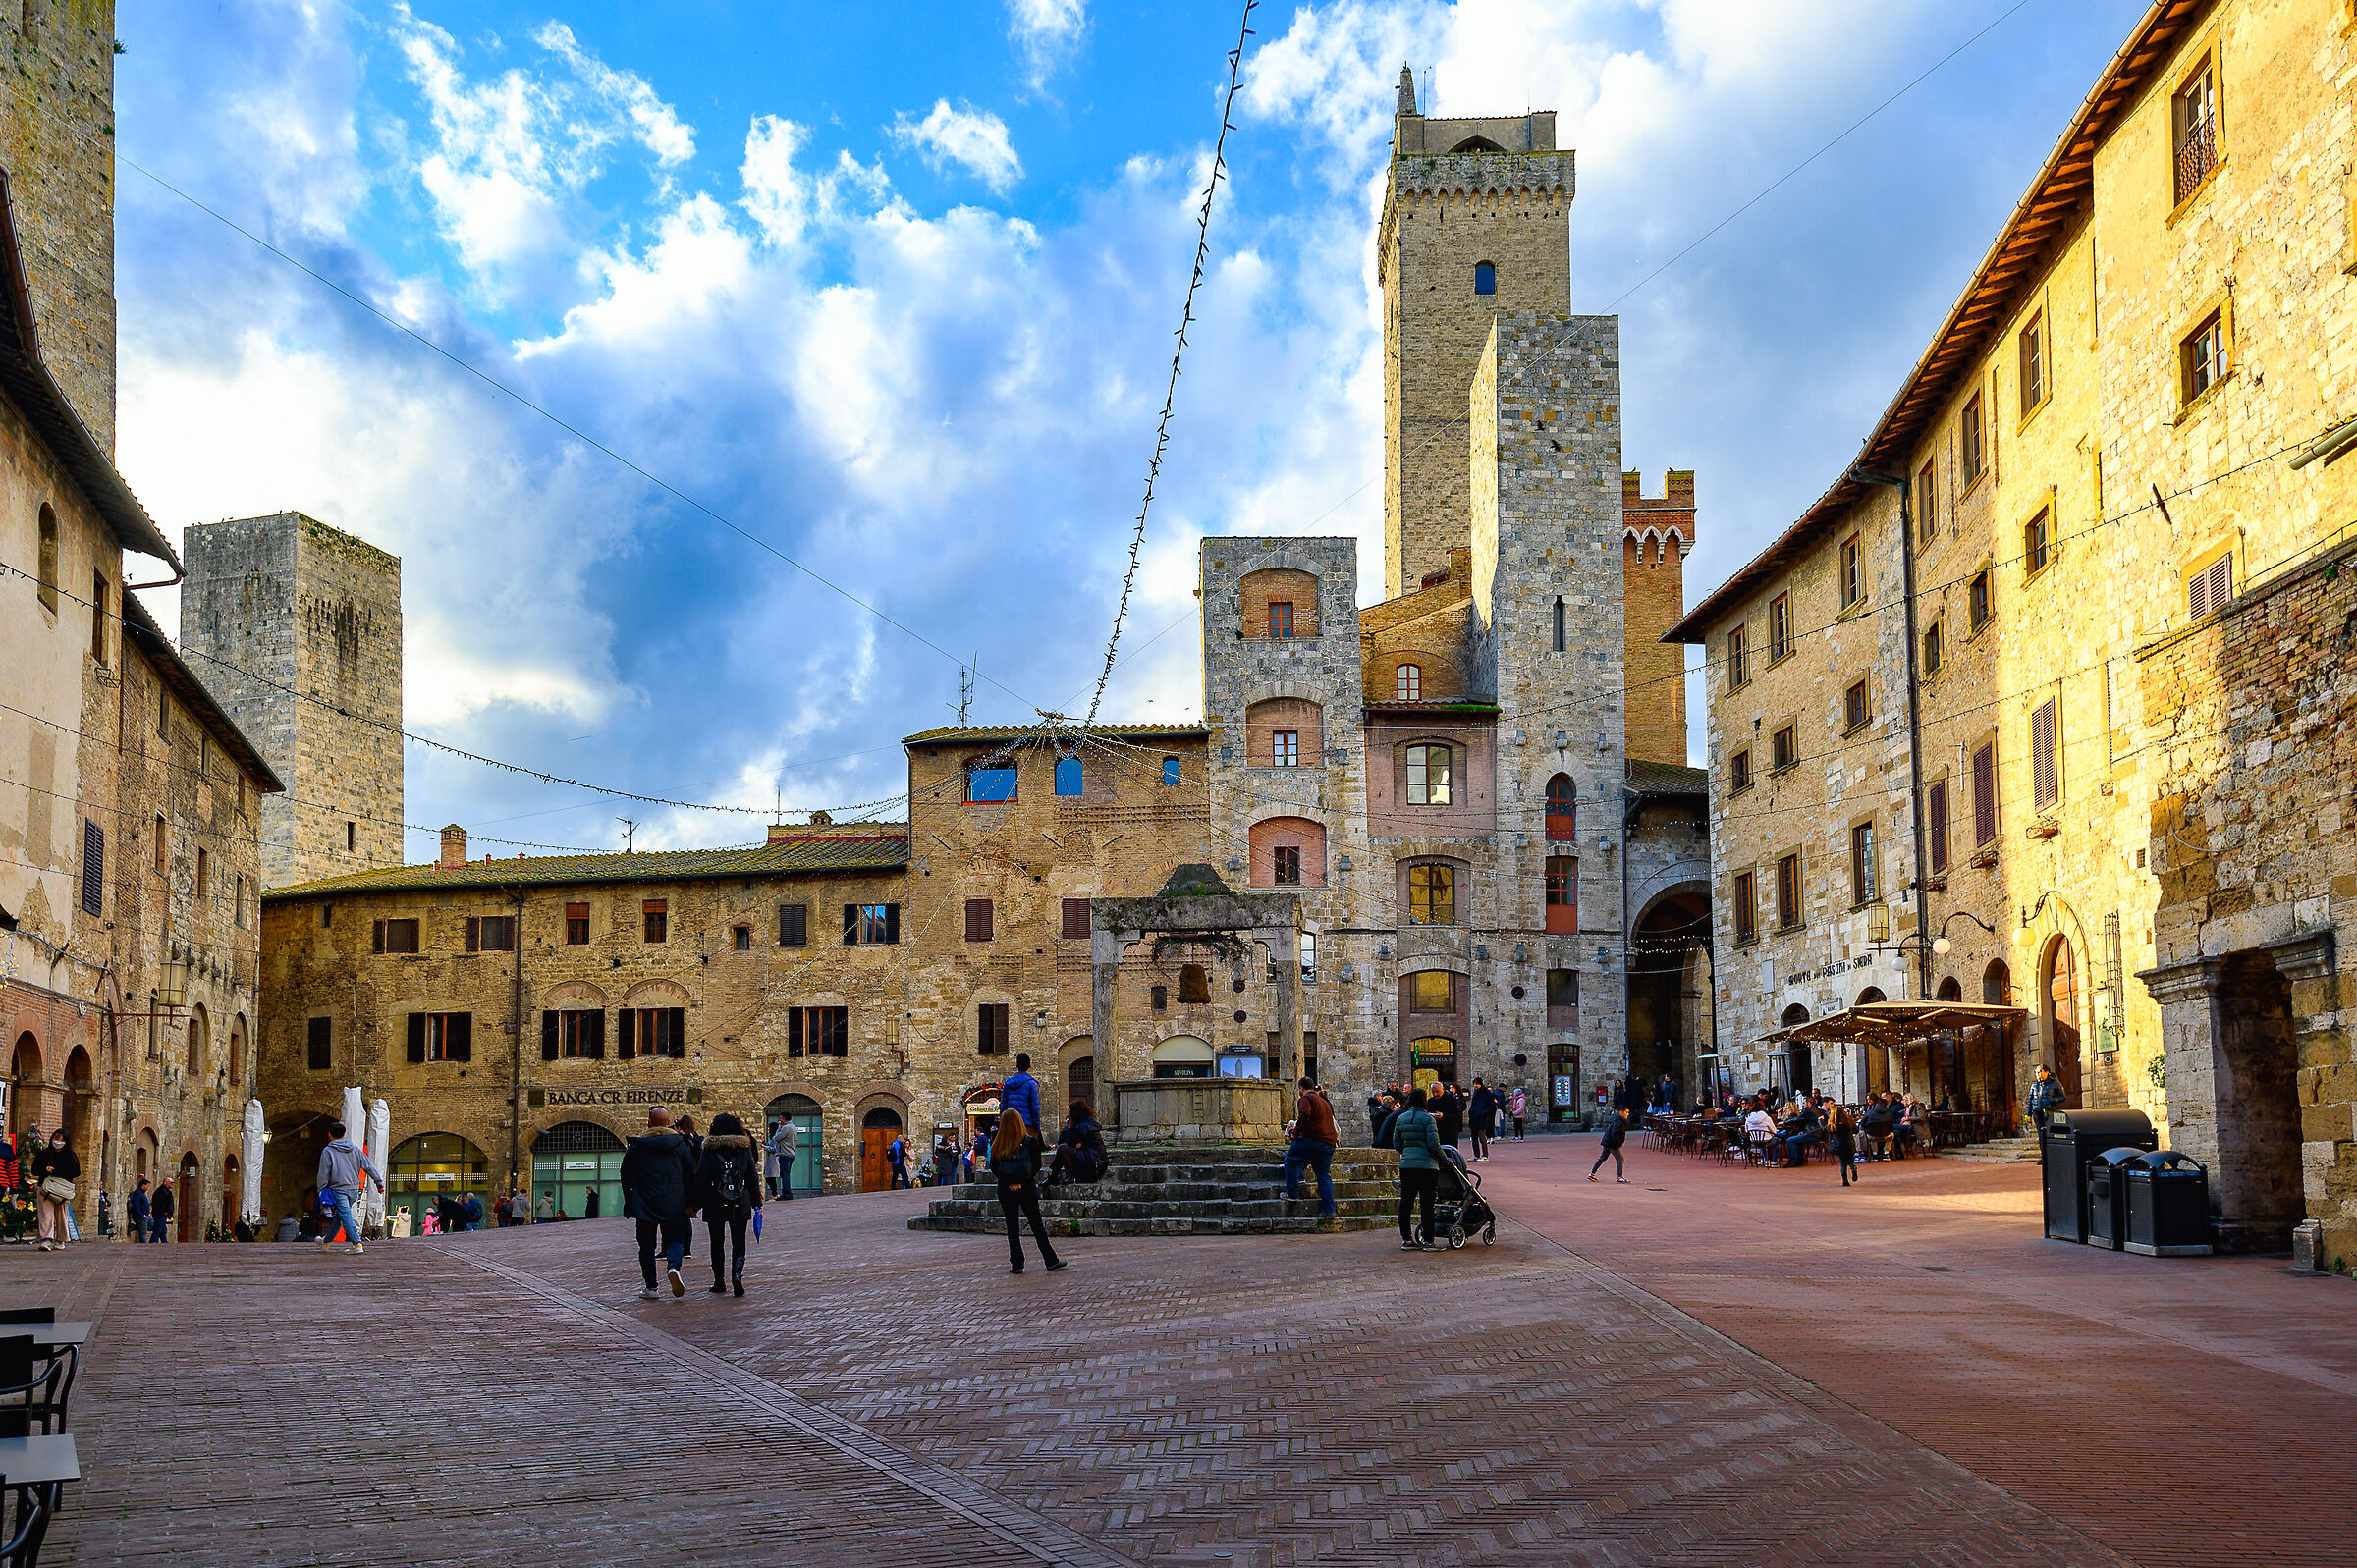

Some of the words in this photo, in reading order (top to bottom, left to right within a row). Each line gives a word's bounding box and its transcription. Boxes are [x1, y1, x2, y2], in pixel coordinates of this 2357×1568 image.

[549, 1092, 597, 1105] BANCA
[600, 1091, 622, 1104] CR
[626, 1090, 684, 1104] FIRENZE
